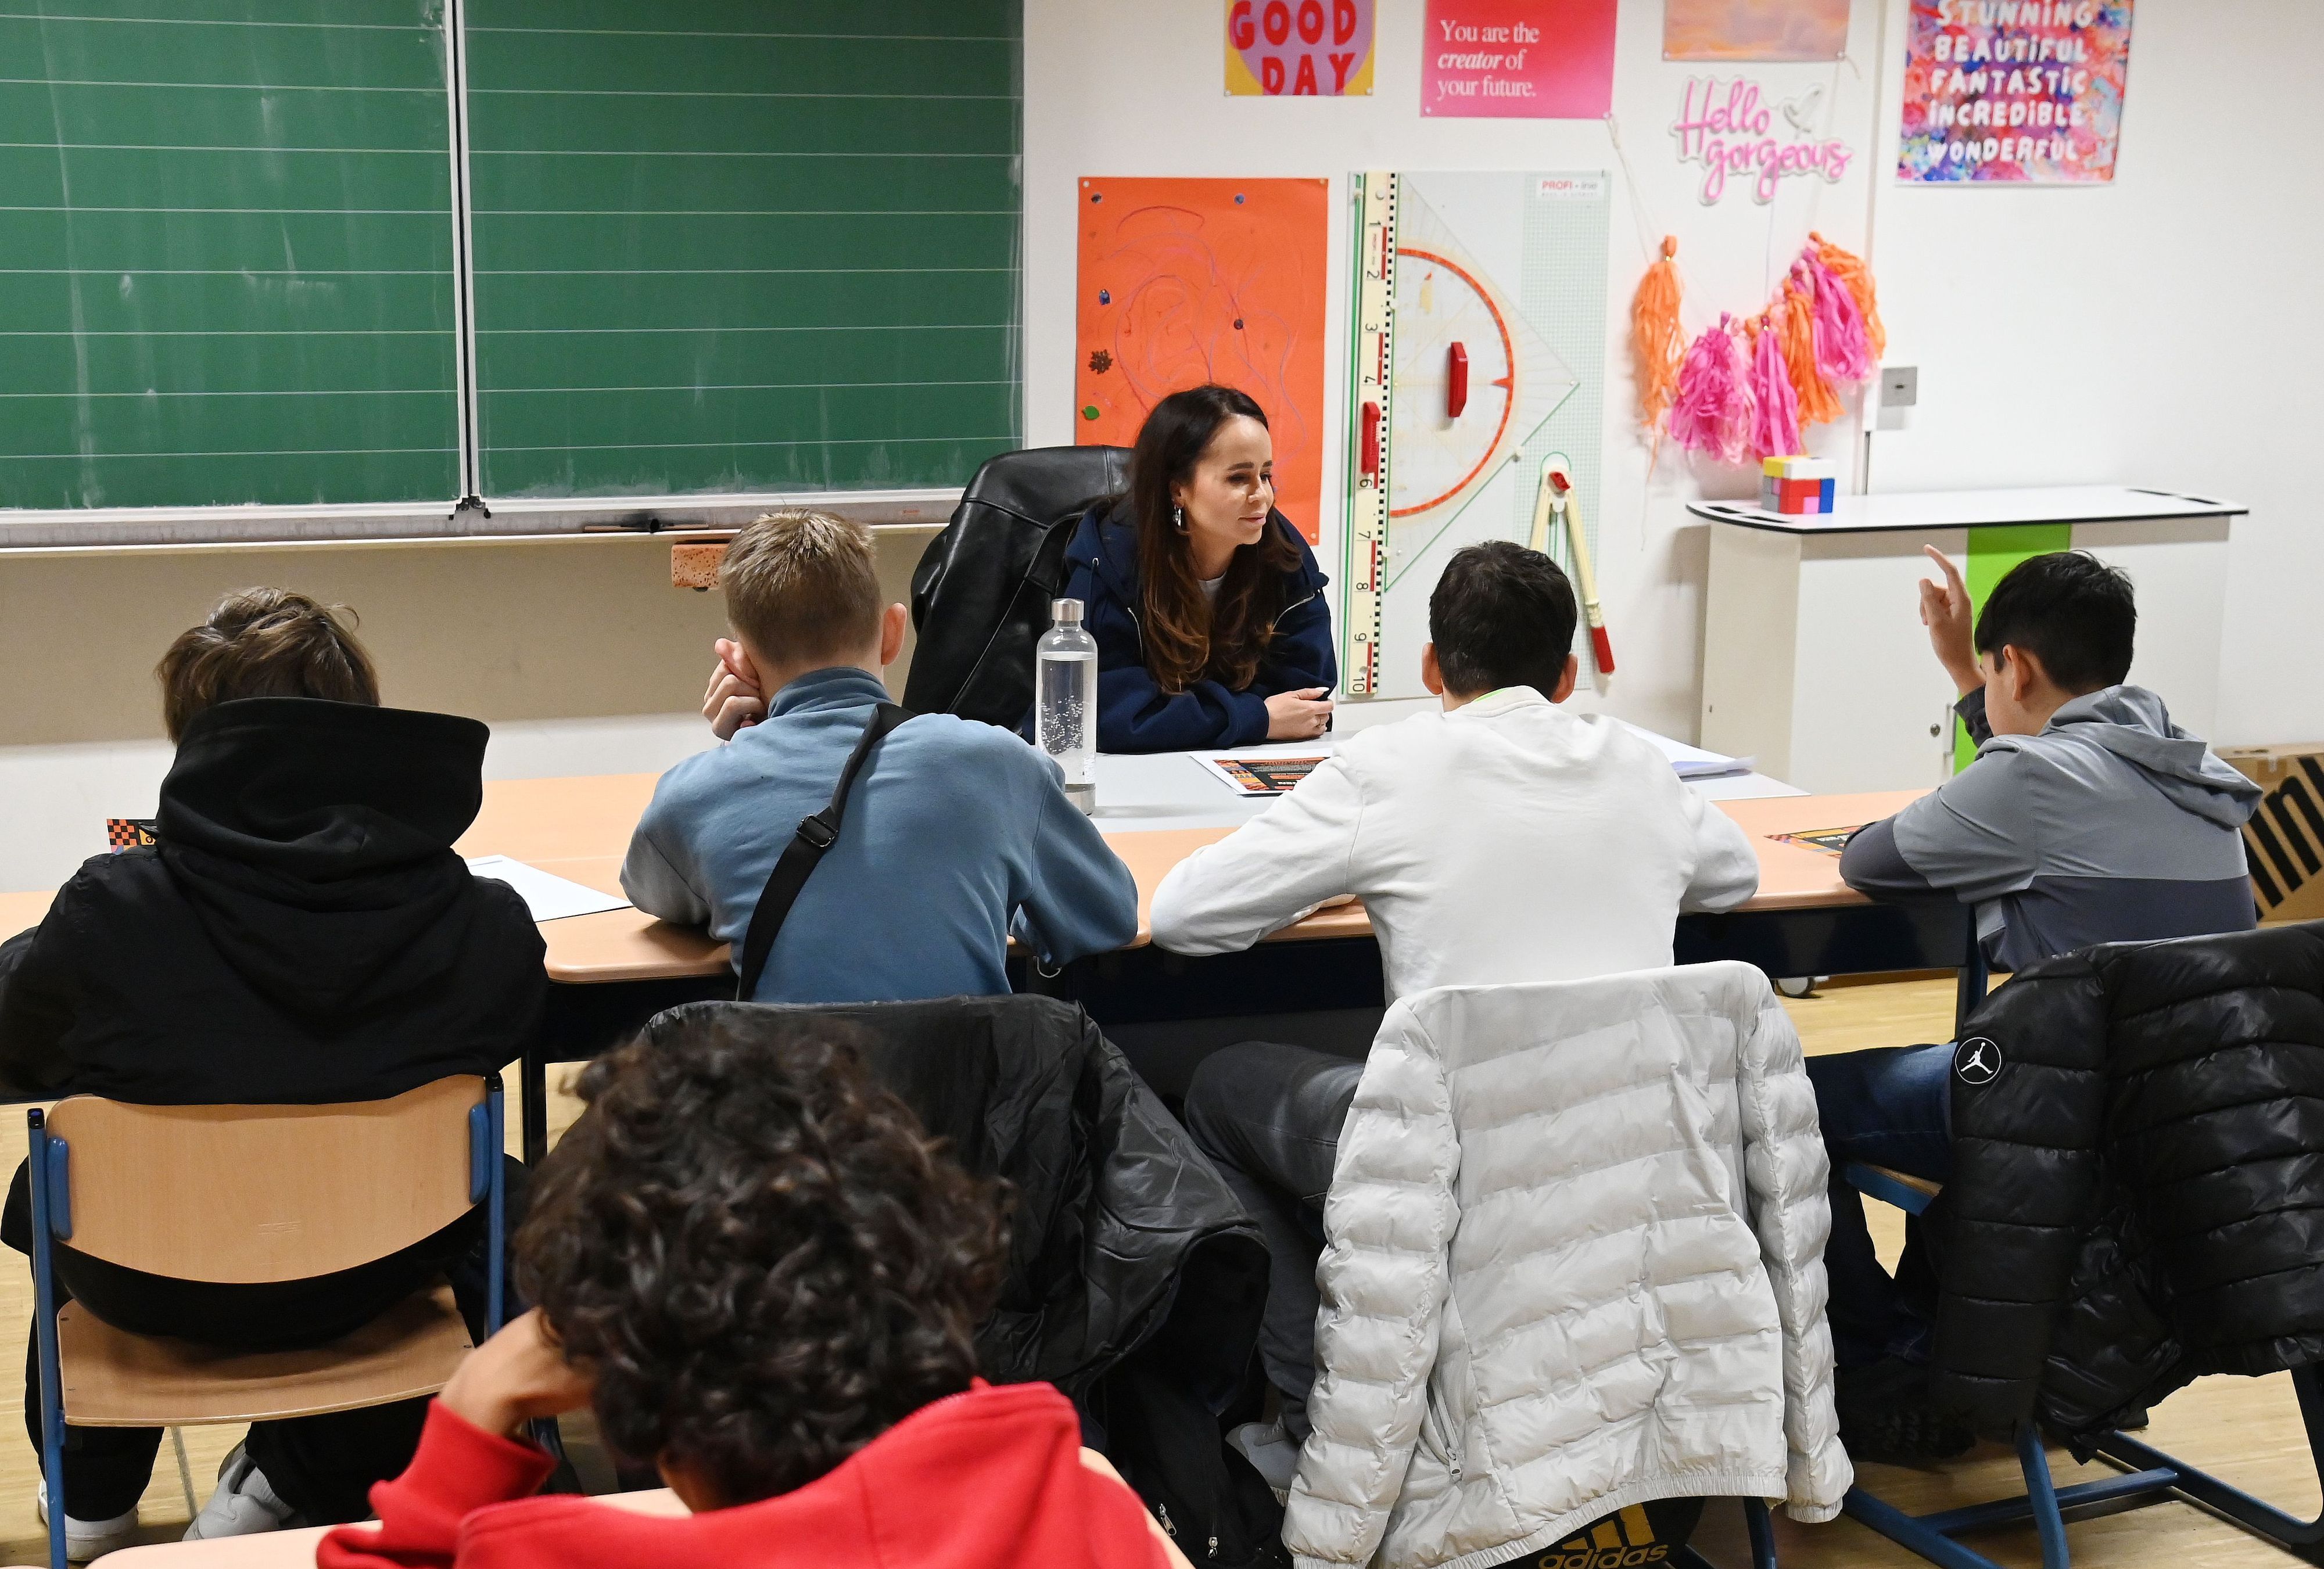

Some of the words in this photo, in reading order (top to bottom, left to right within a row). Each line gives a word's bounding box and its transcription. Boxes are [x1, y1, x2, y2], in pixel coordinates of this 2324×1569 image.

[1229, 0, 1357, 50] GOOD
[1440, 19, 1478, 42] You
[1482, 26, 1510, 43] are
[1513, 21, 1540, 44] the
[1437, 51, 1504, 70] creator
[1505, 48, 1528, 70] of
[1262, 52, 1355, 95] DAY
[1436, 80, 1479, 102] your
[1483, 74, 1537, 98] future.
[1674, 79, 1771, 156] Hello
[1706, 138, 1853, 199] gorgeous
[1366, 270, 1379, 279] 2
[1365, 323, 1378, 332] 3
[1363, 375, 1376, 383] 4
[1359, 479, 1373, 488] 6
[1358, 530, 1371, 539] 7
[1355, 581, 1368, 591] 8
[1354, 632, 1367, 641] 9
[1352, 676, 1365, 692] 10
[1538, 1544, 1669, 1569] adidas
